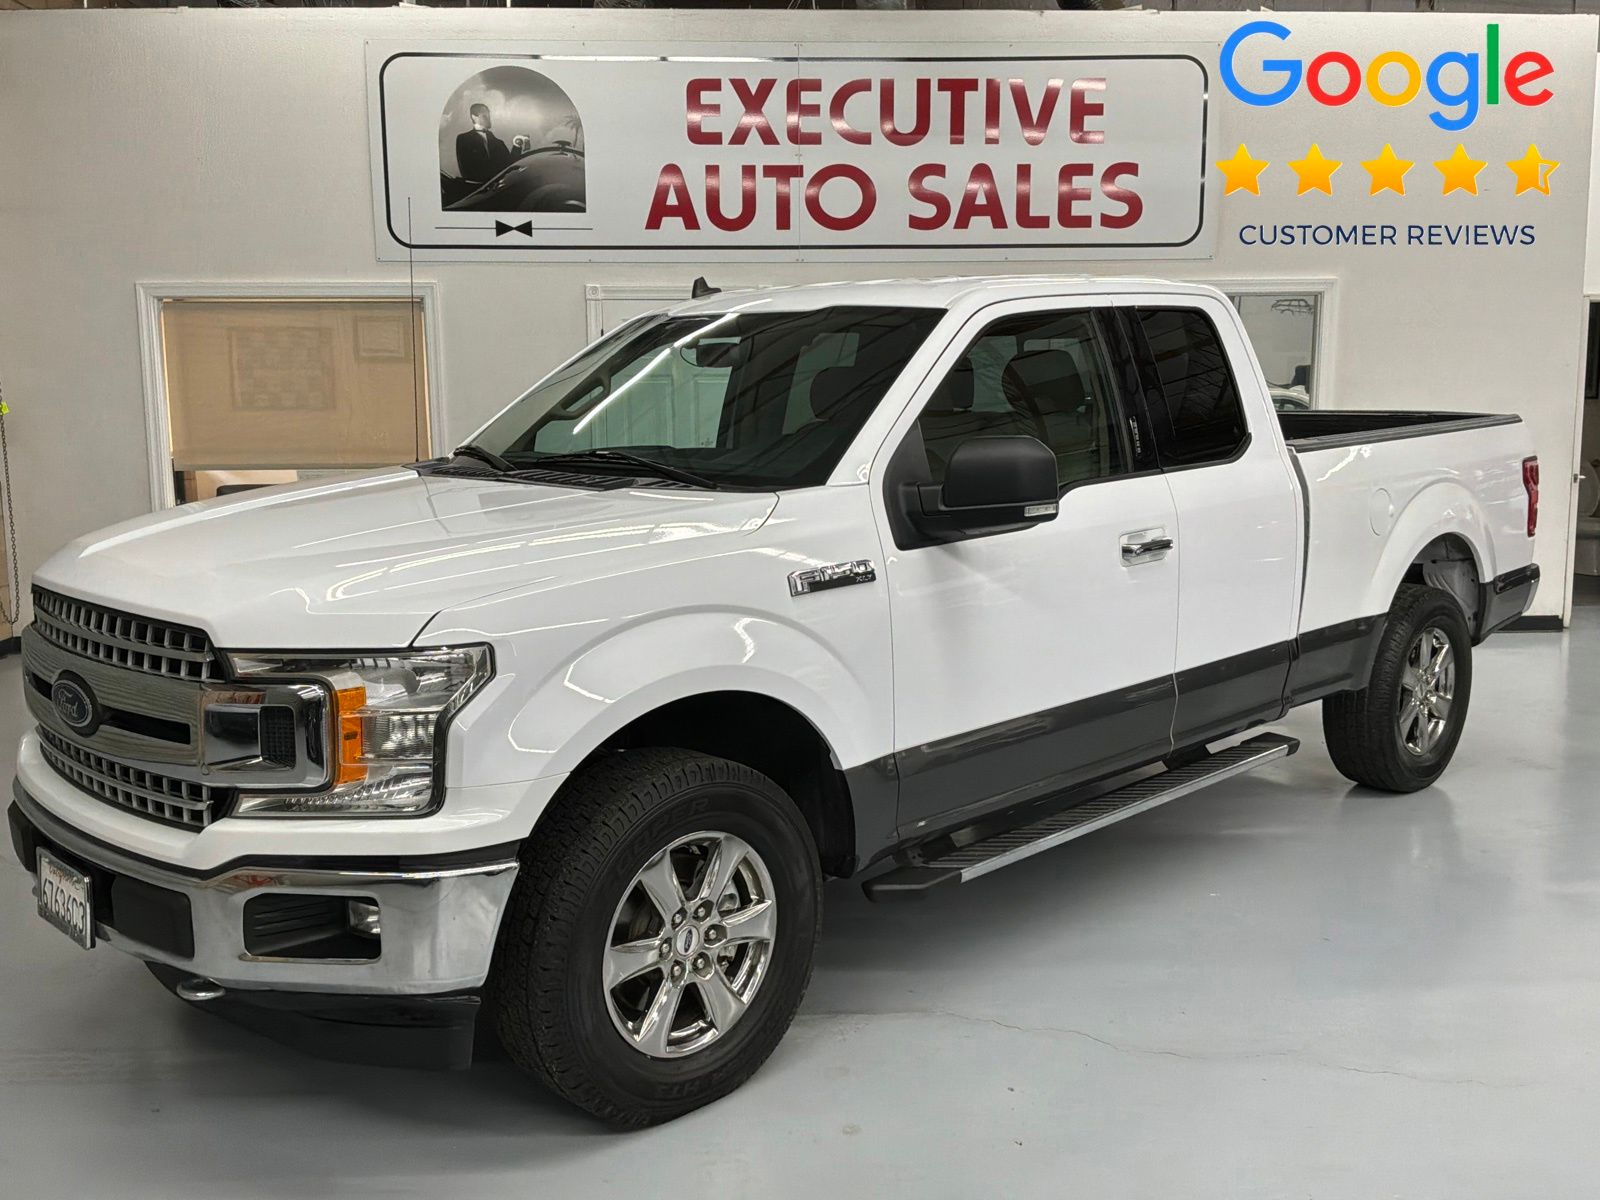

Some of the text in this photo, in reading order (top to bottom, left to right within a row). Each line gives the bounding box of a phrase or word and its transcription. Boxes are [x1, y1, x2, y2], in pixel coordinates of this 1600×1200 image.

[686, 78, 1107, 146] EXECUTIVE
[645, 162, 1144, 232] AUTO SALES
